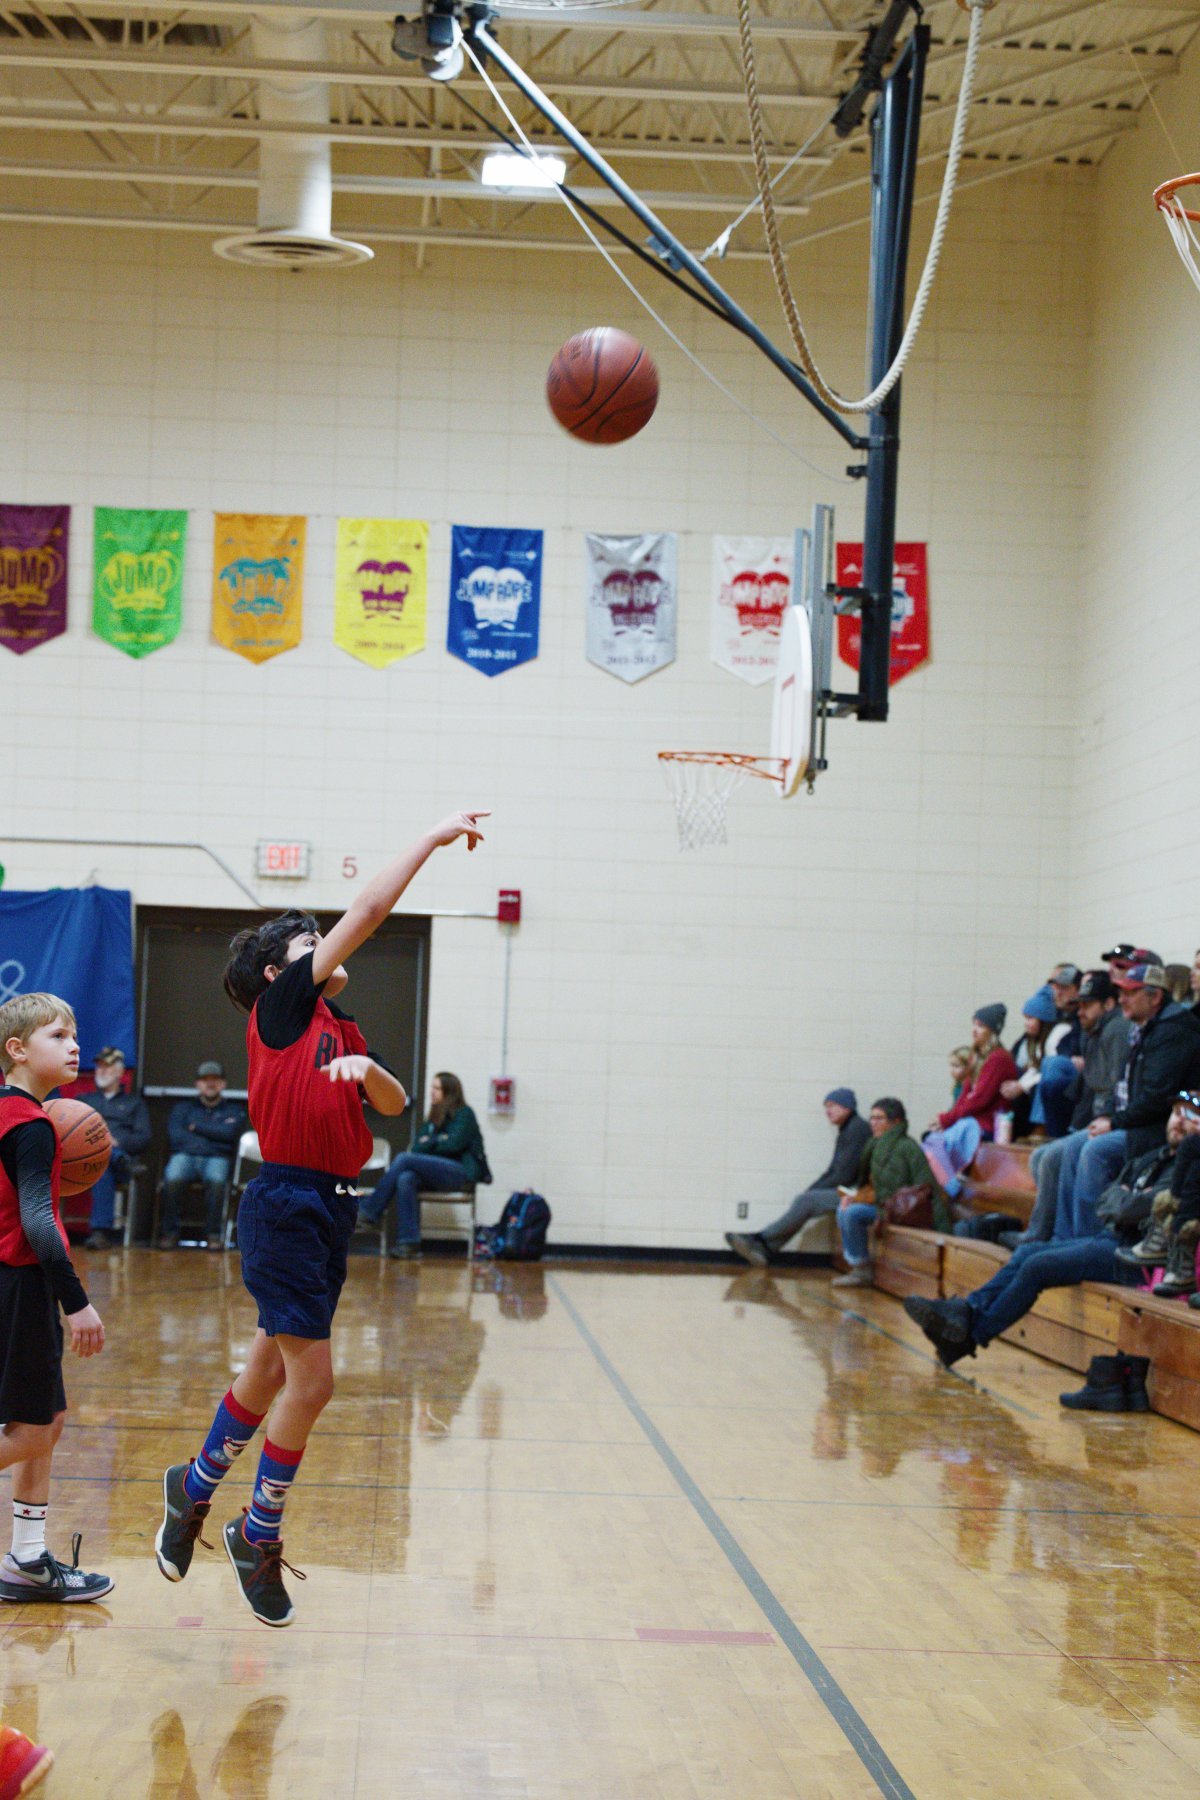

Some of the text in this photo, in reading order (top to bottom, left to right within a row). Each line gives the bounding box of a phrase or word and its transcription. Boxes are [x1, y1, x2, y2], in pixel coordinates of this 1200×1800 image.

[113, 559, 168, 592] JUMP
[456, 577, 495, 602] JUMP
[268, 845, 300, 869] EXIT
[342, 856, 358, 879] 5
